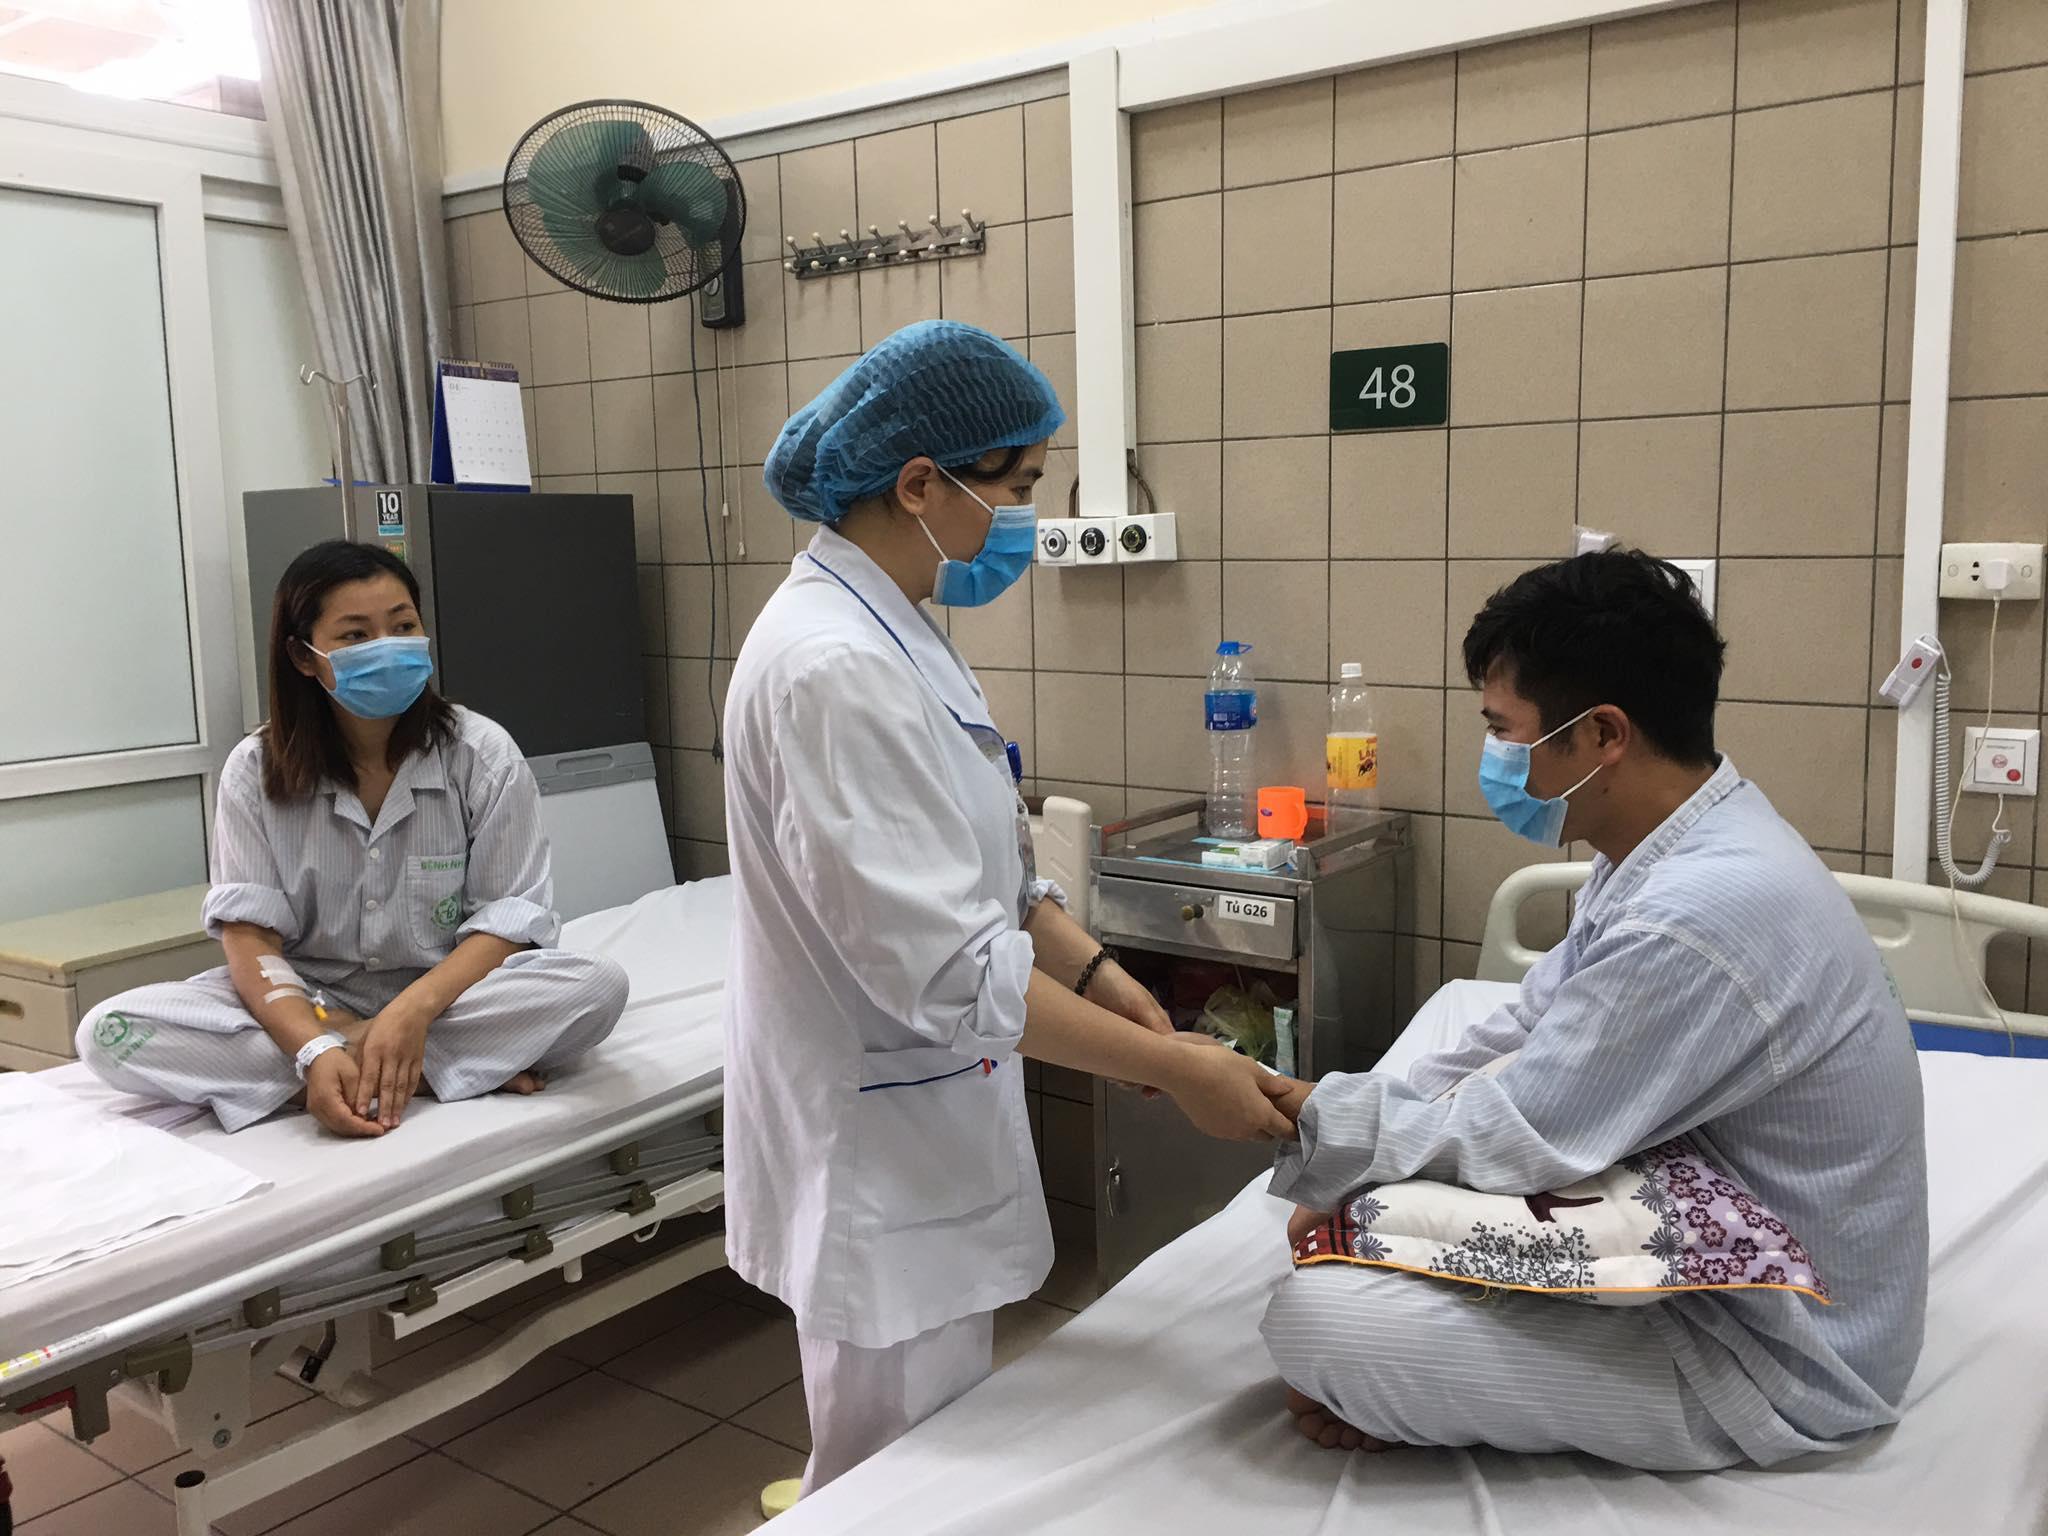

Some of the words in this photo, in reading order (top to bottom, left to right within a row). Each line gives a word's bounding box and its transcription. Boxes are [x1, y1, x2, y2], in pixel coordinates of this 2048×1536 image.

[1358, 364, 1416, 409] 48
[379, 493, 399, 513] 10
[382, 513, 399, 521] YEAR
[1225, 900, 1240, 914] Tủ
[1243, 903, 1268, 918] G26
